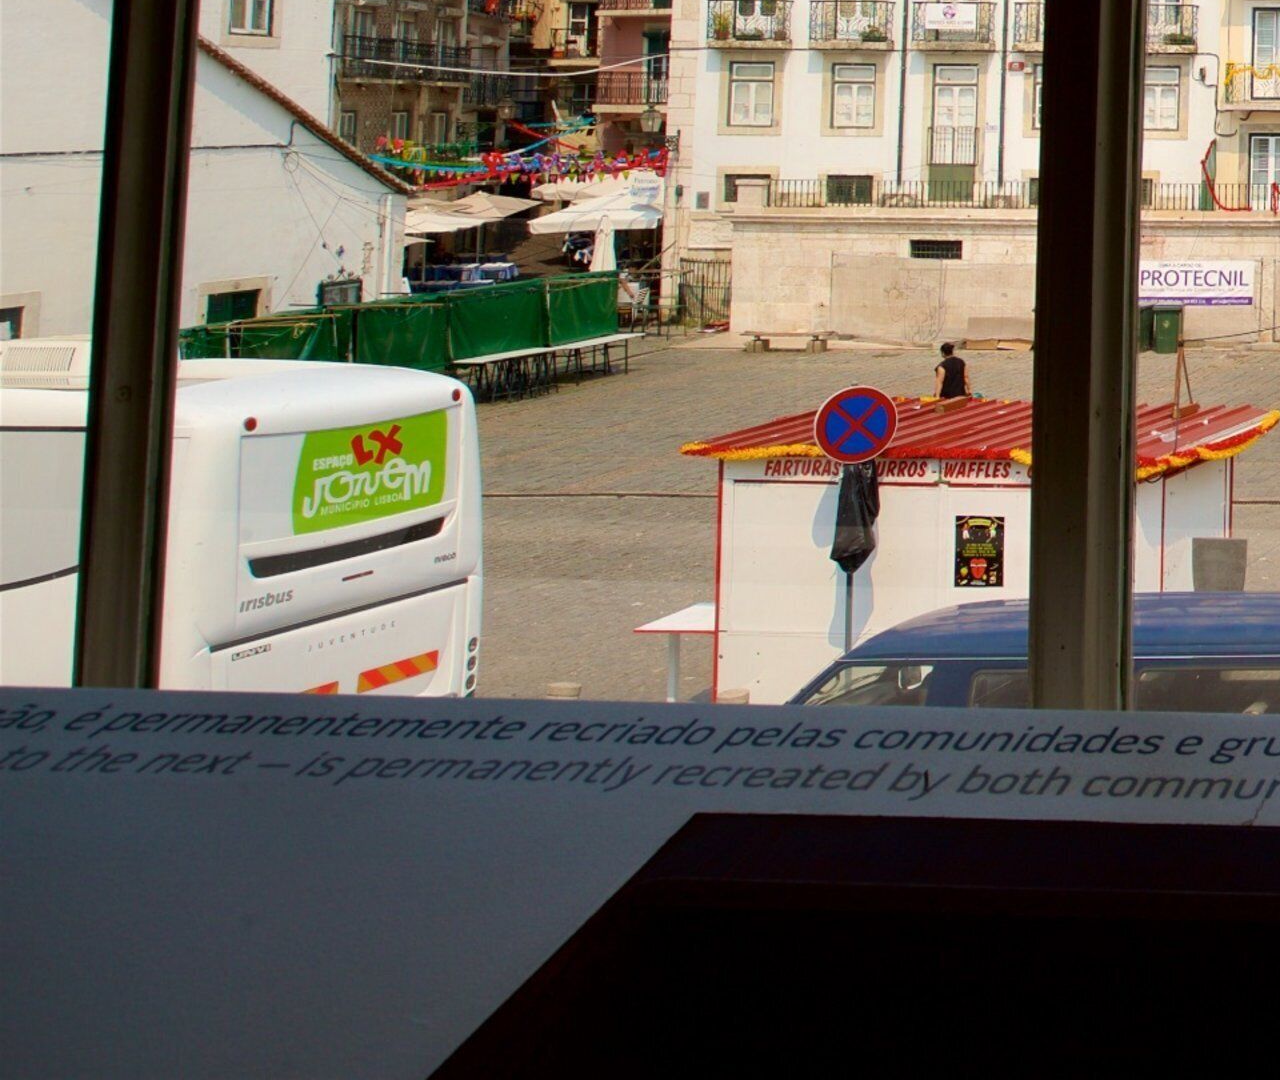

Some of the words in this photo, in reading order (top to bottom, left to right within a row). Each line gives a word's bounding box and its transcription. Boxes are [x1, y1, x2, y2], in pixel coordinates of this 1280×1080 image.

[1140, 269, 1250, 288] PROTECNIL
[350, 423, 403, 467] LX
[312, 452, 353, 471] ESPAÇO
[763, 458, 843, 478] FARTURAS
[876, 461, 929, 478] URROS
[941, 461, 1012, 479] WAFFLES
[374, 492, 404, 508] LISBOA
[307, 620, 397, 653] JUVENTUDE
[0, 702, 57, 734] ão,
[87, 709, 528, 741] permanentemente
[529, 717, 717, 746] recriado
[713, 722, 848, 754] pelas
[853, 725, 1162, 756] comunidades
[1175, 735, 1204, 756] e
[50, 743, 140, 773] the
[135, 749, 253, 776] next
[294, 750, 345, 778] is
[331, 754, 655, 793] permanently
[651, 762, 892, 793] recreated
[887, 762, 952, 802] by
[956, 764, 1068, 797] both
